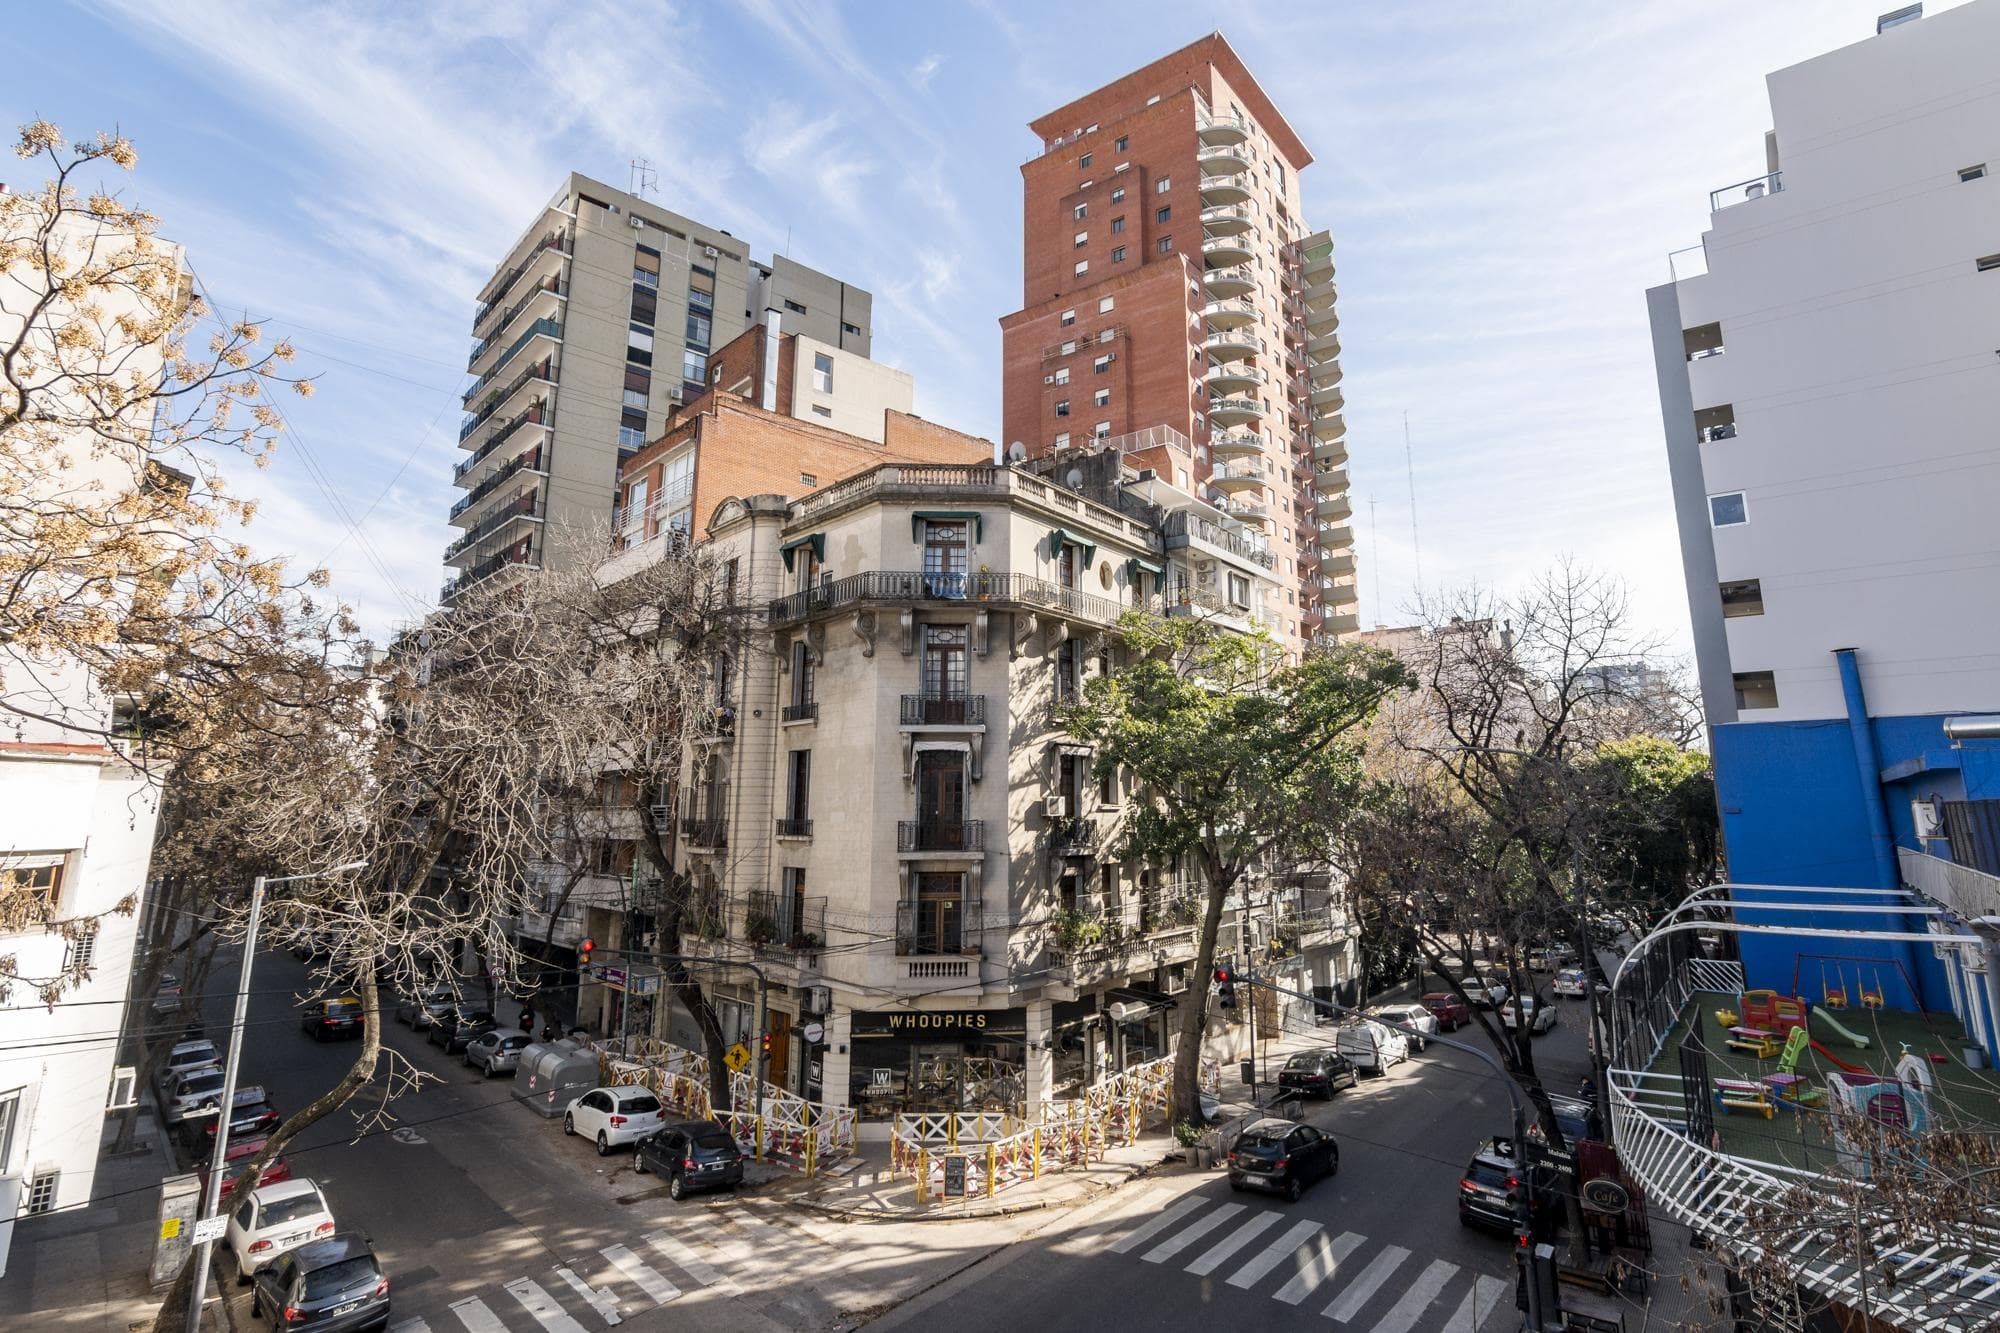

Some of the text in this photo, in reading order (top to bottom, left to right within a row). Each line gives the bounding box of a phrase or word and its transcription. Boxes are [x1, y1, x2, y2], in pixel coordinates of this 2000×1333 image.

[889, 1014, 986, 1028] WHOOPIES
[812, 1065, 819, 1078] W
[876, 1072, 888, 1085] W
